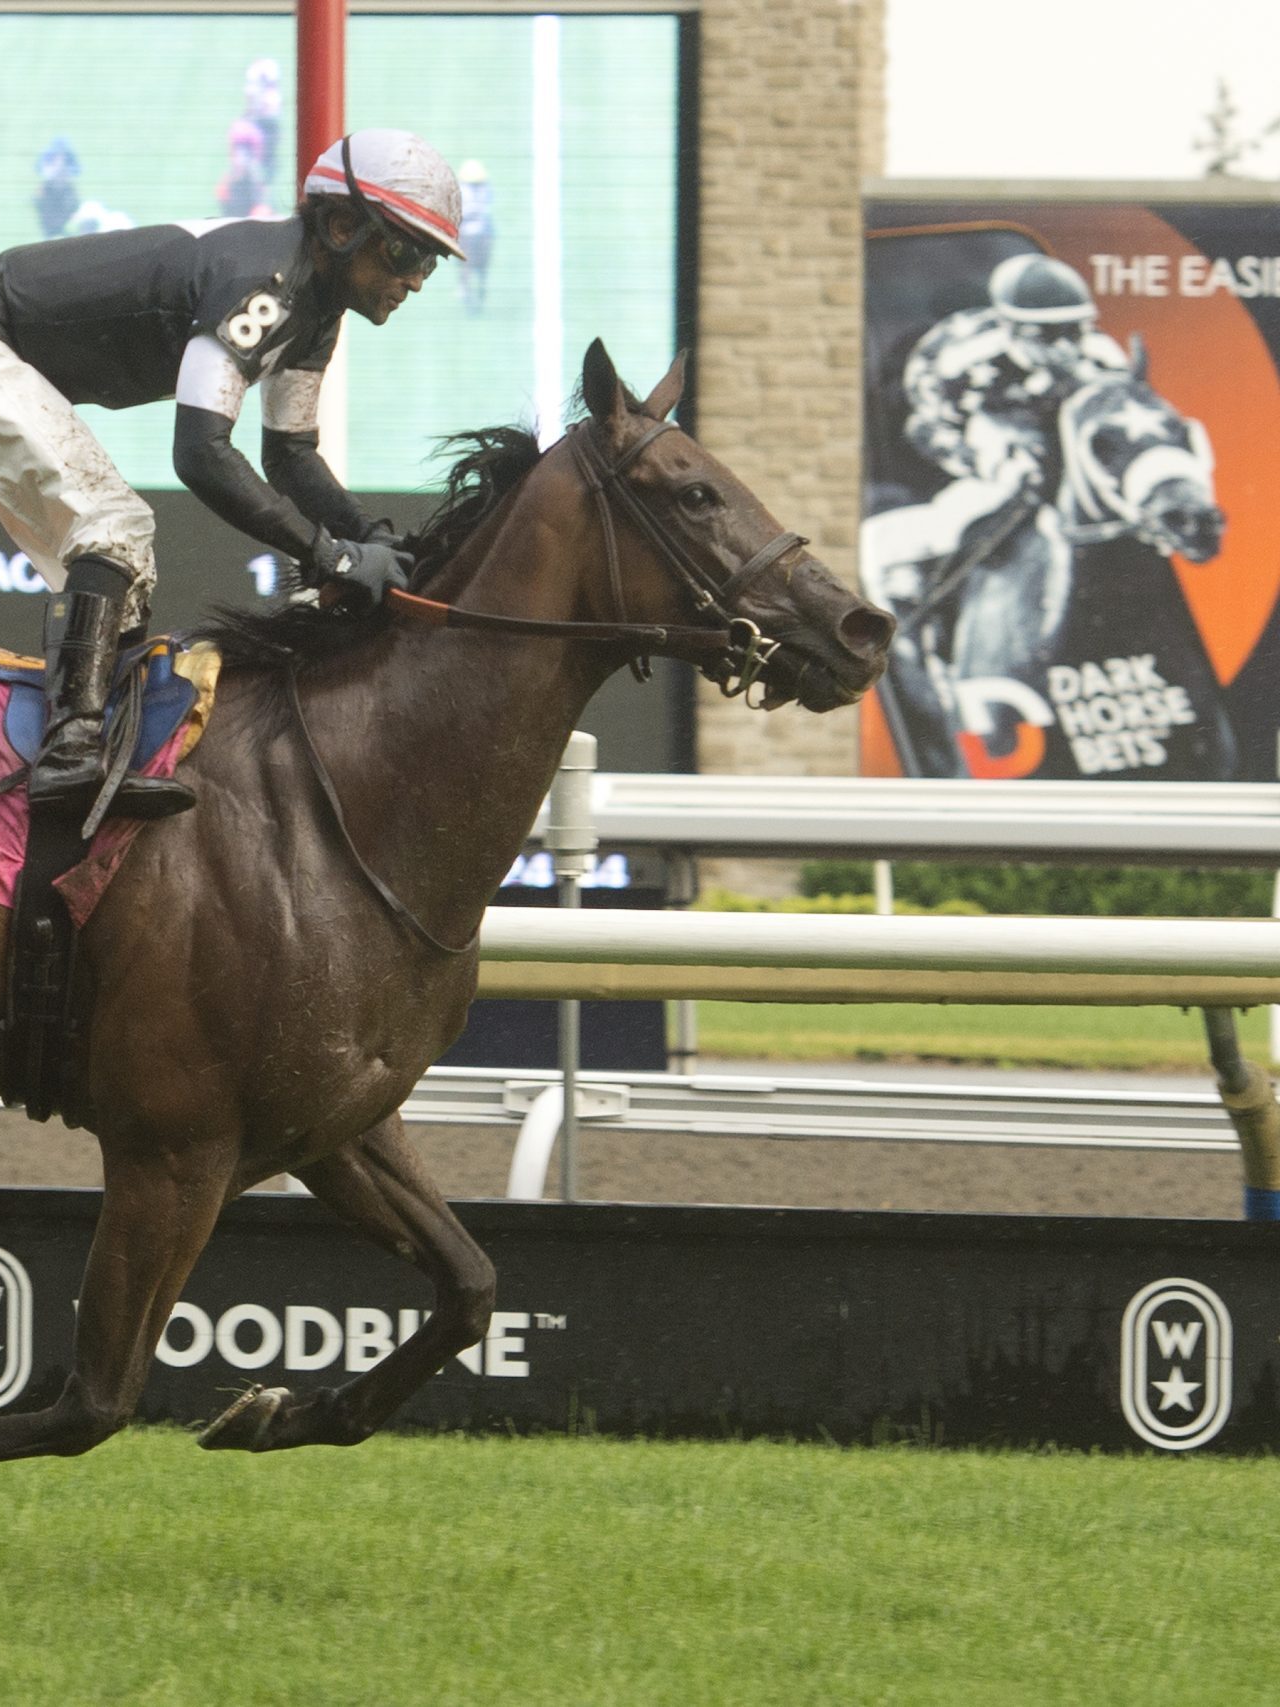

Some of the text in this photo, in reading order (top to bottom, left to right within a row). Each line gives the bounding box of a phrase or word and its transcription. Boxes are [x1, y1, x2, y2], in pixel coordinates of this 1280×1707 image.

[1089, 254, 1169, 297] THE
[229, 293, 279, 349] 8
[1047, 654, 1167, 703] DARK
[1057, 686, 1197, 741] HORSE
[72, 1299, 530, 1378] OODBIE
[1151, 1320, 1203, 1359] W
